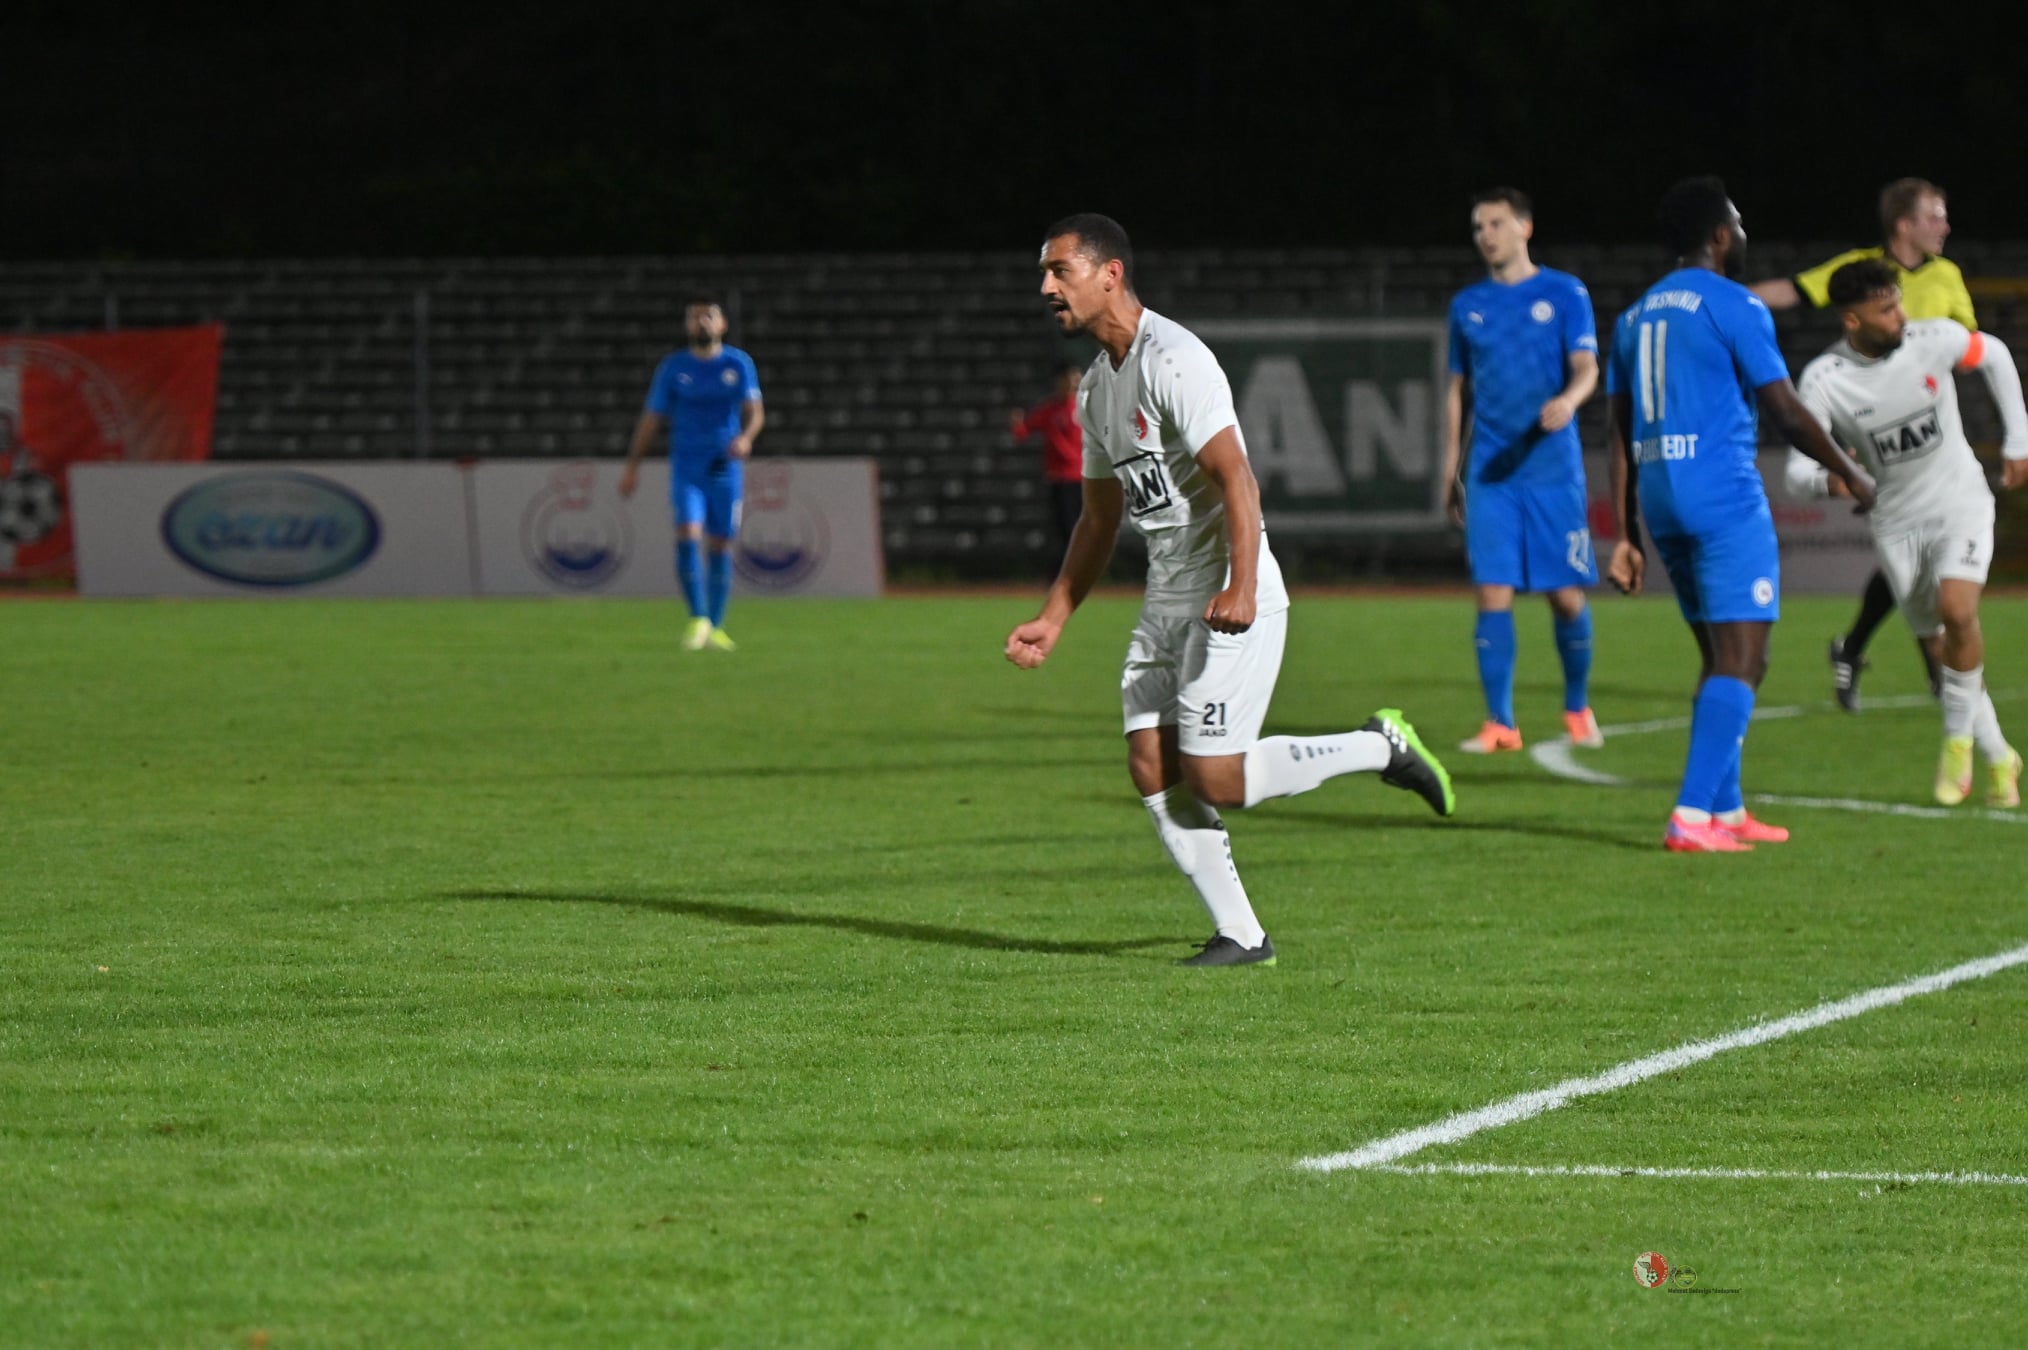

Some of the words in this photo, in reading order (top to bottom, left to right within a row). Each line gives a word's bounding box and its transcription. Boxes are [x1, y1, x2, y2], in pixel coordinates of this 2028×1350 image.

[1639, 319, 1667, 424] 11
[1240, 356, 1430, 495] AN
[1124, 468, 1162, 509] AN
[1202, 702, 1226, 726] 21
